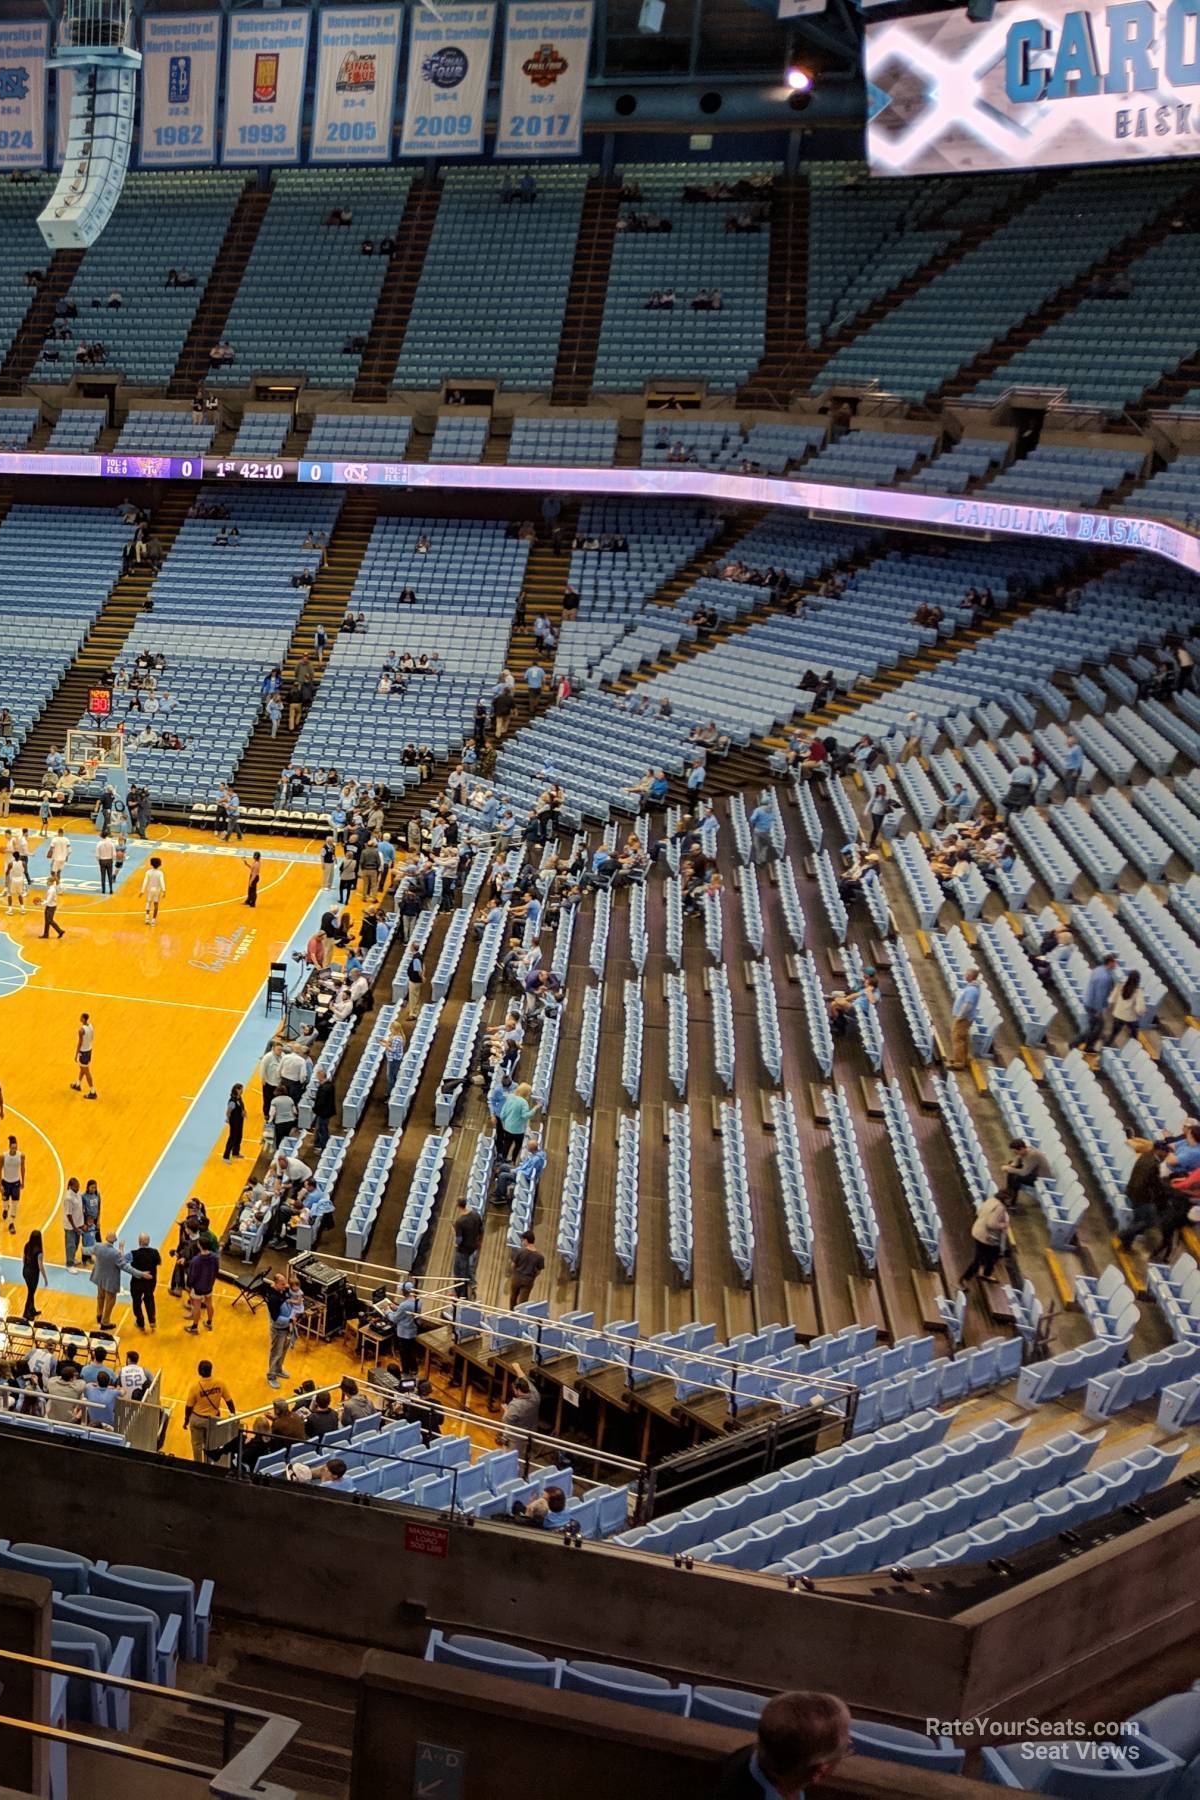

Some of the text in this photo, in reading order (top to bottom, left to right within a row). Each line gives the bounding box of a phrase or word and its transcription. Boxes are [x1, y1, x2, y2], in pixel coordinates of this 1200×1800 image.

[414, 115, 472, 137] 2009
[510, 114, 570, 137] 2017
[1115, 103, 1200, 139] BASK
[154, 125, 203, 146] 1982
[239, 124, 287, 144] 1993
[327, 122, 376, 142] 2005
[106, 459, 121, 467] TOL:
[182, 461, 192, 476] 0
[216, 462, 283, 479] 1ST 42:10
[310, 465, 321, 479] 0
[954, 502, 1068, 537] CAROLINA
[92, 698, 108, 711] 30
[125, 1374, 142, 1387] 52
